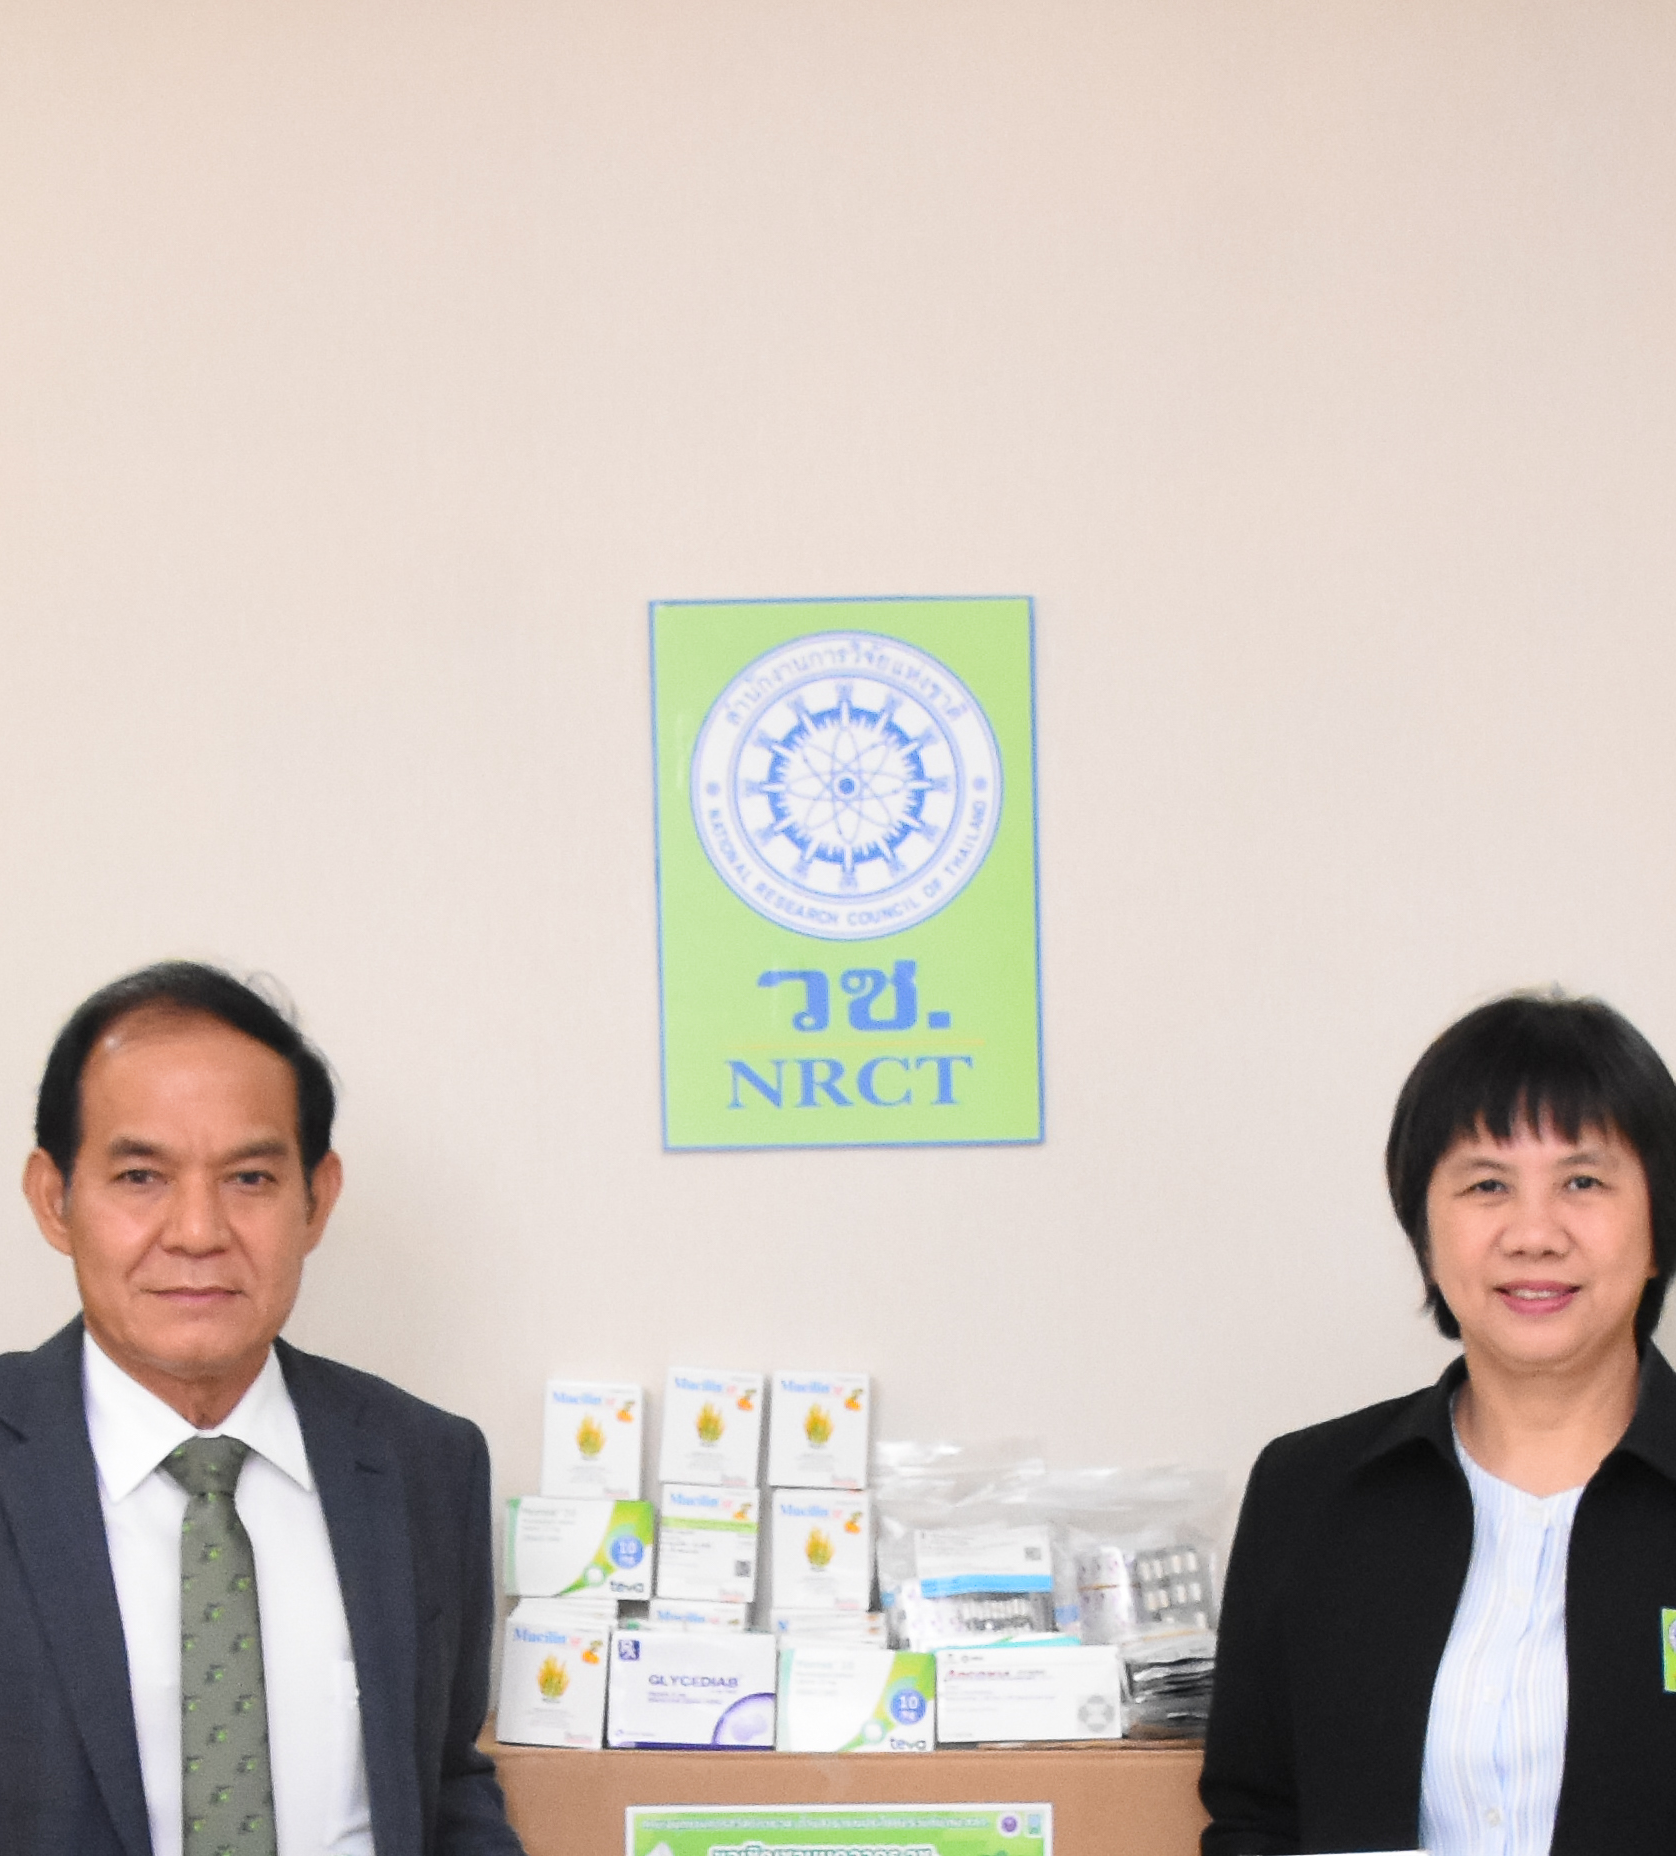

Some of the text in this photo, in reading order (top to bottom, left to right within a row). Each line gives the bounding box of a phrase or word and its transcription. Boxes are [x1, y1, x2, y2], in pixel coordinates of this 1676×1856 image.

[709, 800, 987, 925] NATIONAL RESEARCH COUNCIL OF THAILAND
[756, 959, 952, 1032] วช.
[726, 1055, 974, 1109] NRCT
[610, 1581, 644, 1593] teva
[648, 1674, 737, 1688] GLYCEDIAB
[900, 1695, 918, 1709] 10
[890, 1738, 927, 1750] teva
